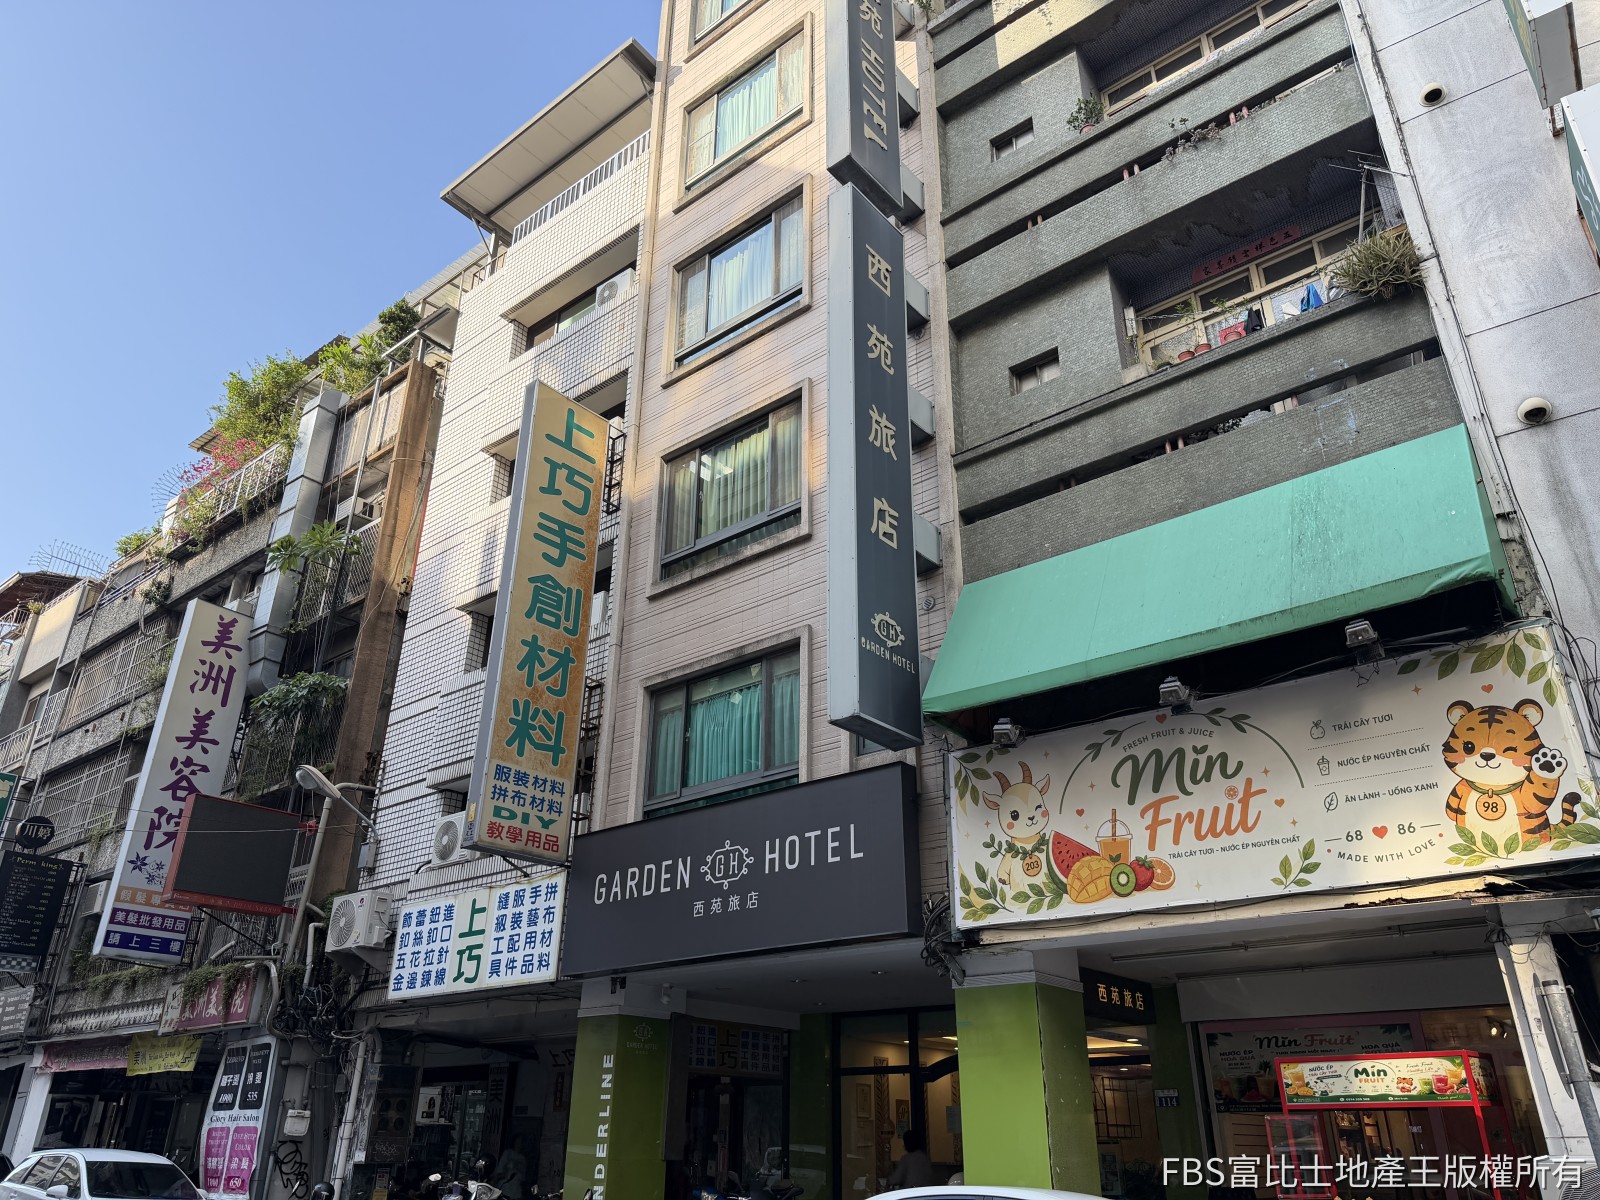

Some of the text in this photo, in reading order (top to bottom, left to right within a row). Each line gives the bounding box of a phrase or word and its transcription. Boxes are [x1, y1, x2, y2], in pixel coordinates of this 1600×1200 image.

[861, 37, 888, 151] HOTEL
[866, 244, 899, 550] 西苑旅店
[505, 407, 597, 767] 上巧手創材料
[861, 636, 916, 674] GARDEN HOTEL
[1332, 713, 1394, 732] TRÁI CÂY TƯƠI
[1122, 727, 1215, 753] FRESH FRUIT & JUICE
[1337, 742, 1431, 768] NƯỚC ÉP NGUYÊN CHẤT
[493, 763, 565, 798] 服裝材料
[1111, 745, 1244, 806] Min
[490, 783, 563, 817] 拼布材料
[1344, 781, 1439, 804] ĂN LÀNH UỐNG XANH
[492, 805, 559, 829] DIY
[1139, 777, 1267, 852] Fruit
[1482, 802, 1499, 813] 98
[486, 820, 560, 853] 教學用品
[1345, 822, 1416, 843] 68 86
[1168, 834, 1301, 860] TRÁI CÂY TƯƠI NƯỚC ÉP NGUYÊN CHẤT
[1337, 838, 1436, 863] MADE WITH LOVE
[593, 823, 864, 905] GARDEN GH HOTEL
[1025, 859, 1040, 871] 203
[693, 891, 759, 917] 西苑旅店
[114, 910, 186, 932] 美髮批發用品
[504, 888, 526, 977] 服裝配件
[520, 885, 542, 975] 手藝用品
[537, 881, 558, 973] 拼布材料
[108, 932, 181, 953] 請上三樓
[392, 911, 414, 992] 飾釦五金
[405, 909, 427, 990] 蕾絲花邊
[433, 903, 455, 987] 進口針線
[452, 898, 487, 984] 上巧
[1097, 983, 1144, 1010] 西苑旅店
[1354, 1065, 1388, 1078] Min
[1162, 1096, 1177, 1107] 114
[227, 1114, 241, 1122] Hair
[243, 1114, 260, 1122] Salon
[229, 1177, 242, 1188] 650
